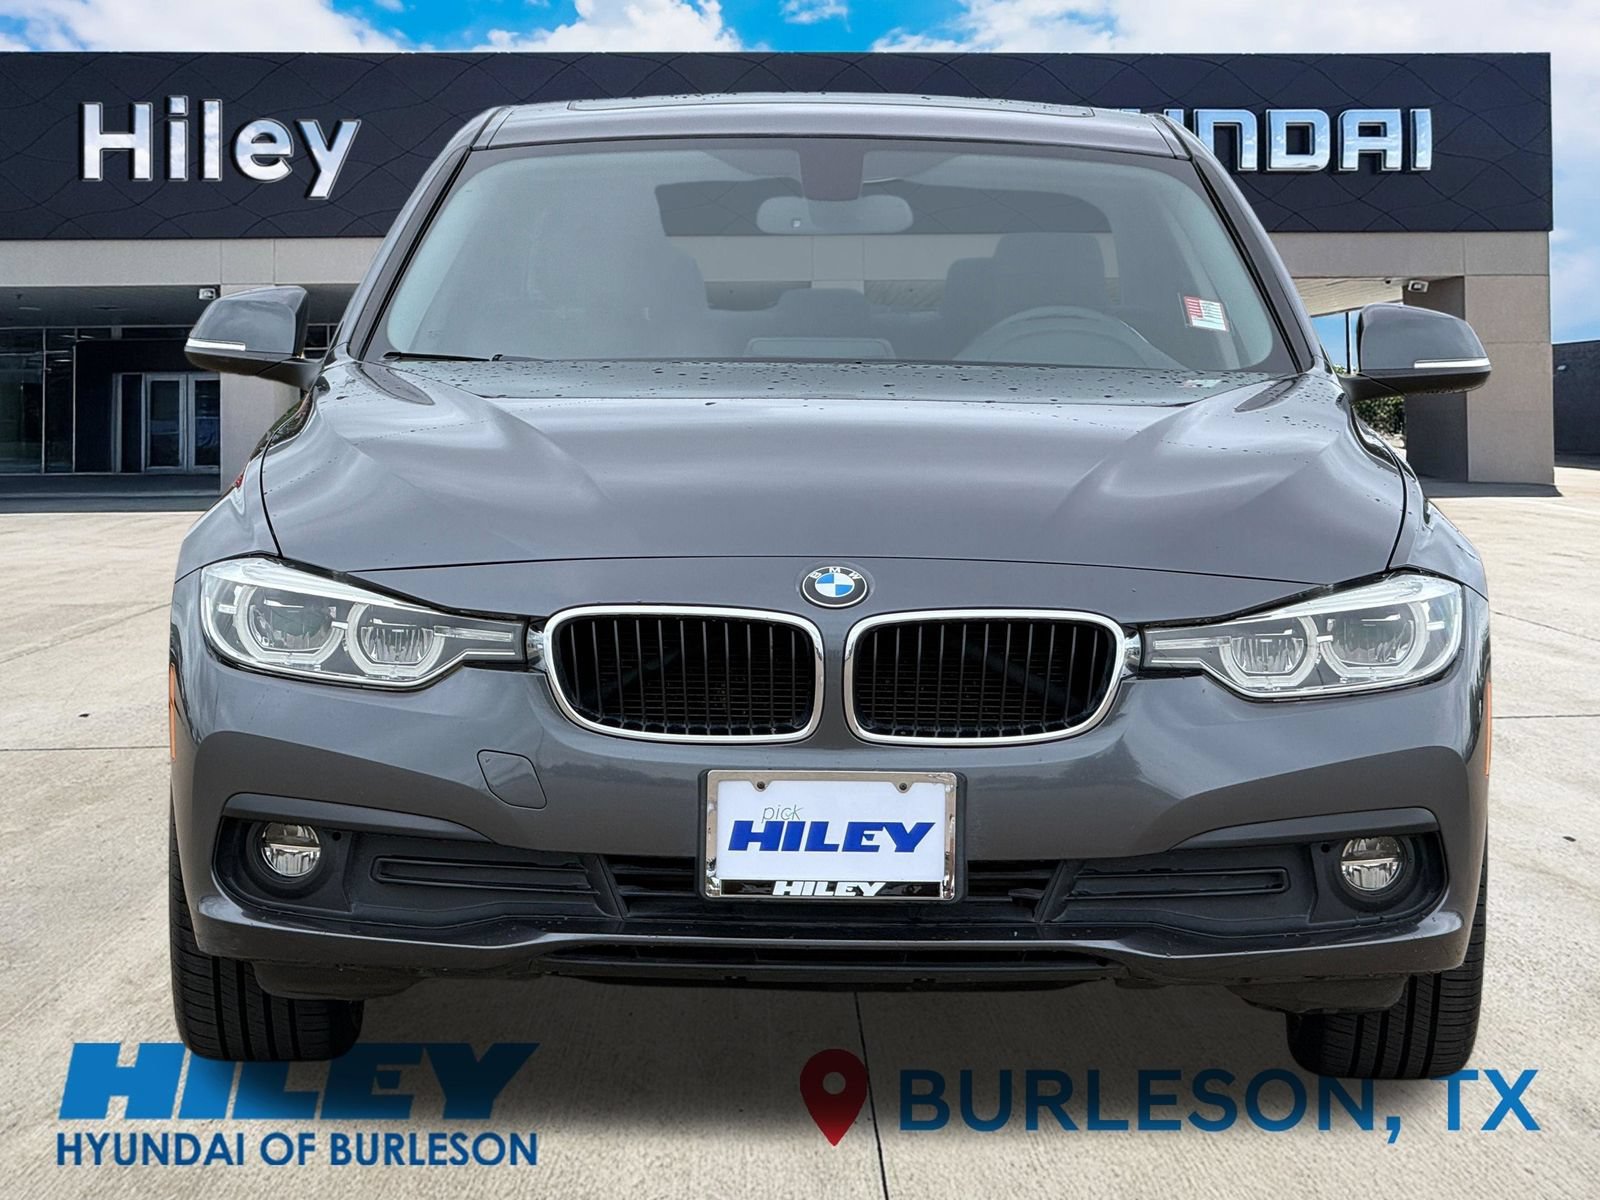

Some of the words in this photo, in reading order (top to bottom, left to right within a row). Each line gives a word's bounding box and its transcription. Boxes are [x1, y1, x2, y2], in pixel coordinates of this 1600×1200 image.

[80, 95, 361, 199] Hiley
[1120, 108, 1433, 171] NDAI
[810, 567, 862, 579] BMW
[761, 804, 803, 824] pick
[728, 820, 936, 853] HILEY
[772, 880, 886, 896] HILEY
